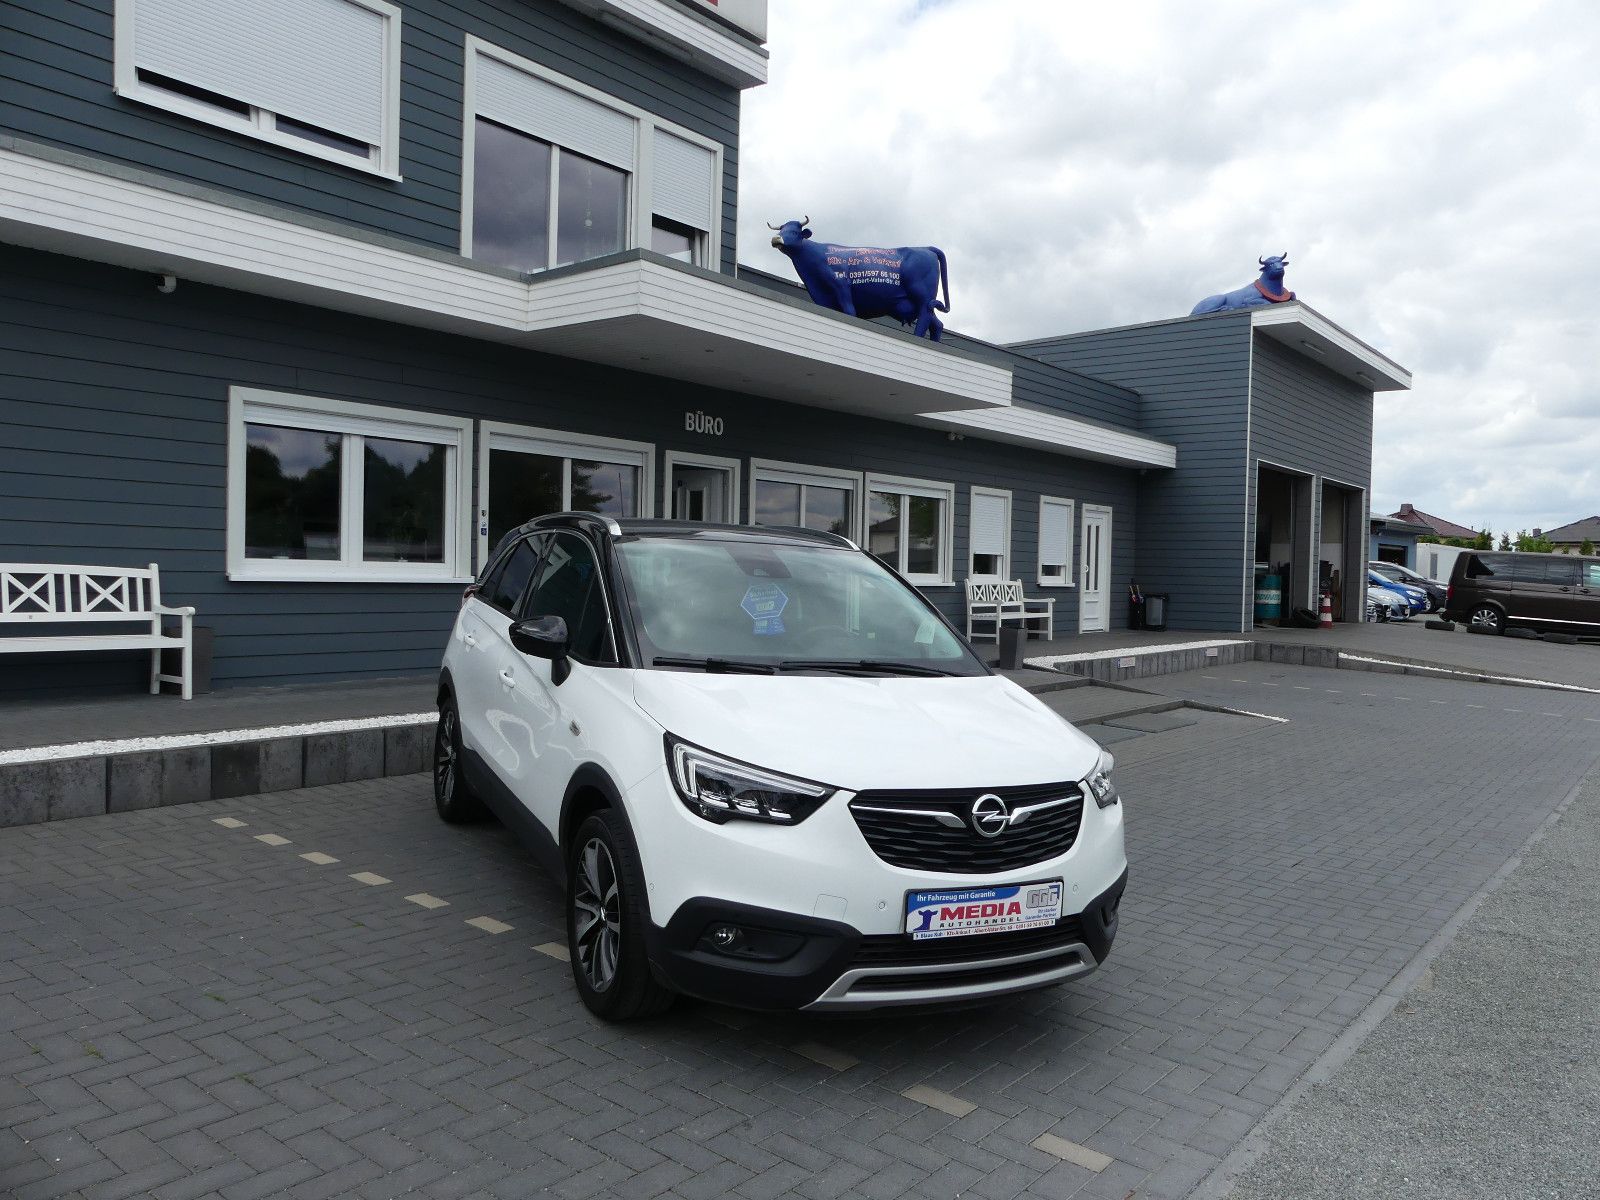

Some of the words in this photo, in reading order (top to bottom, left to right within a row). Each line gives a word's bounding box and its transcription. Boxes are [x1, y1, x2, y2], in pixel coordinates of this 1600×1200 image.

[835, 271, 847, 279] Tel.
[849, 271, 879, 279] 0391/597
[685, 410, 724, 436] BÜRO
[917, 894, 926, 902] Ihr
[927, 893, 958, 902] Fahrzeug
[958, 892, 969, 900] mit
[970, 890, 996, 899] Garantie
[940, 901, 1021, 921] MEDIA
[940, 917, 1021, 928] AUTOHANDEL
